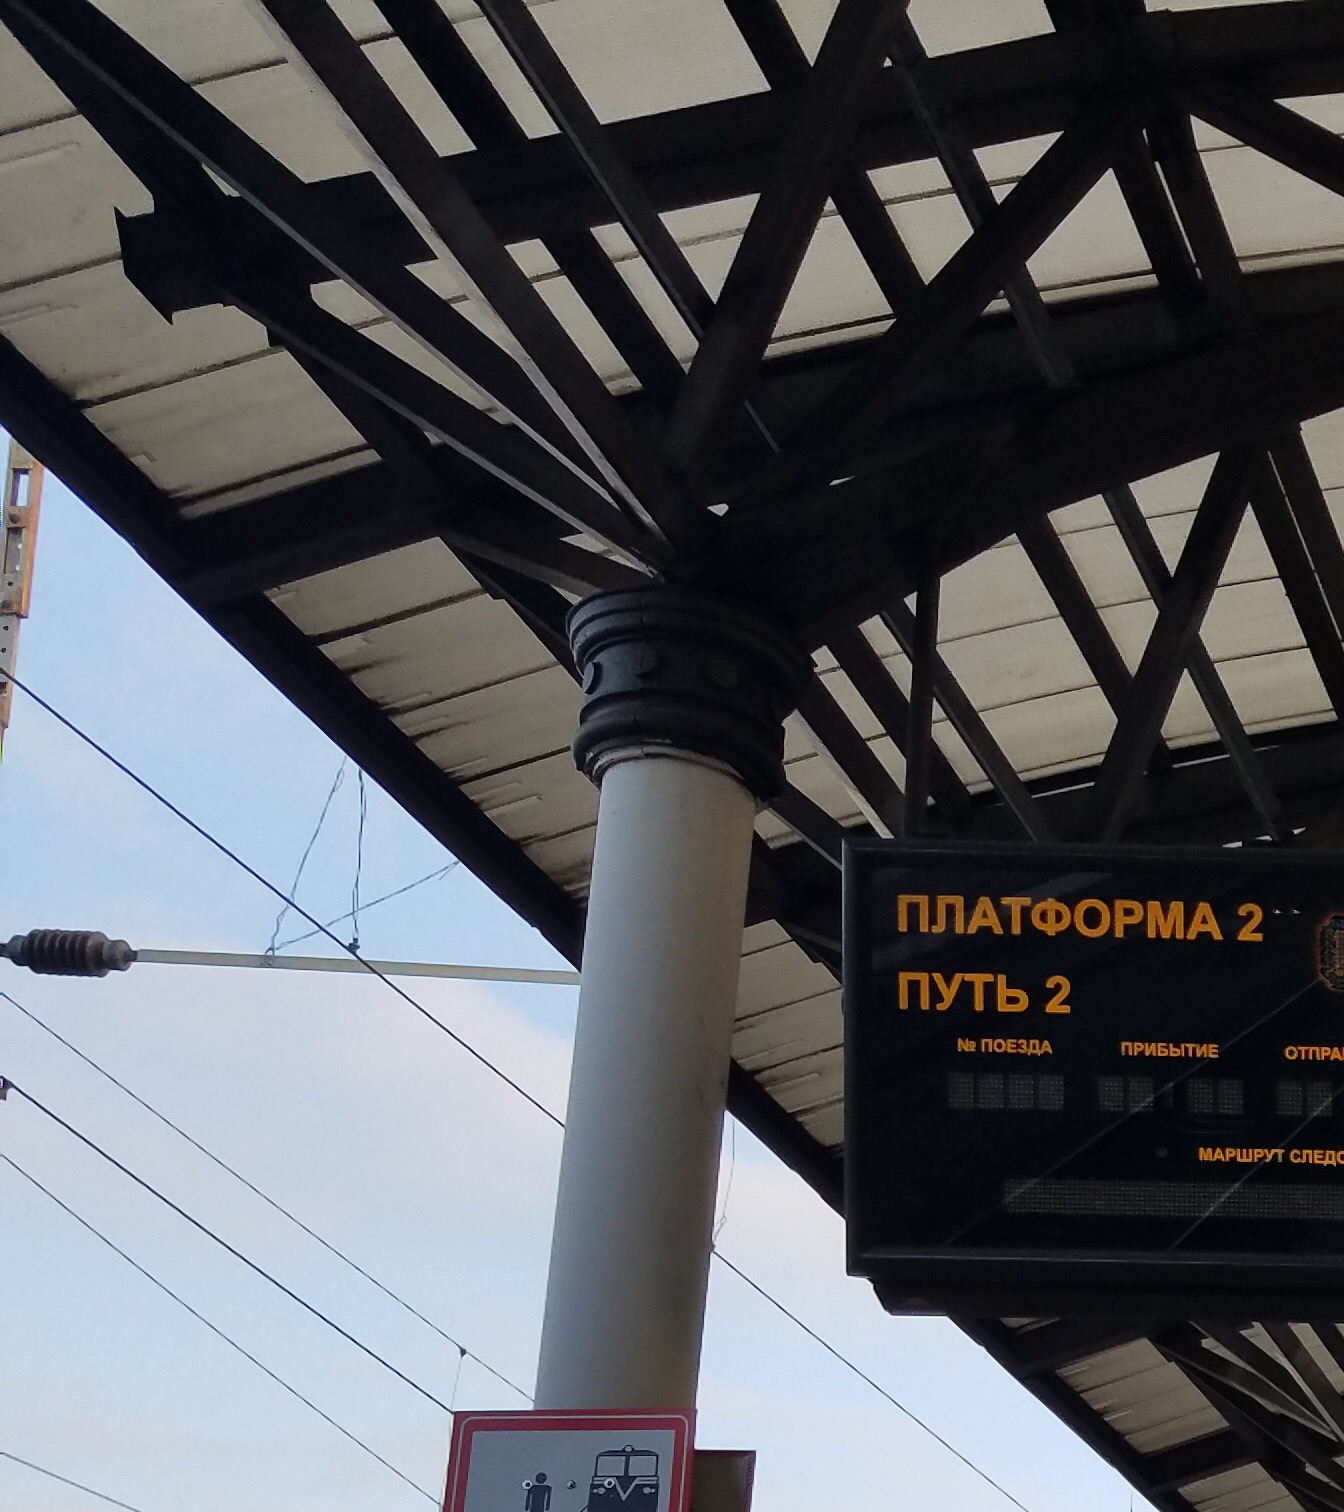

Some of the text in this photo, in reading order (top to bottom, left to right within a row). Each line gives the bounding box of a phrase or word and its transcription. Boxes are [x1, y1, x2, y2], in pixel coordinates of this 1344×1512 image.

[896, 894, 1265, 942] ПЛАТФОРМА 2
[897, 971, 1072, 1014] ПУТЬ 2
[956, 1038, 1053, 1055] № ПОЕЗДА
[1120, 1041, 1219, 1058] ПРИБЫТИЕ
[1197, 1147, 1285, 1163] МАРШРУТ
